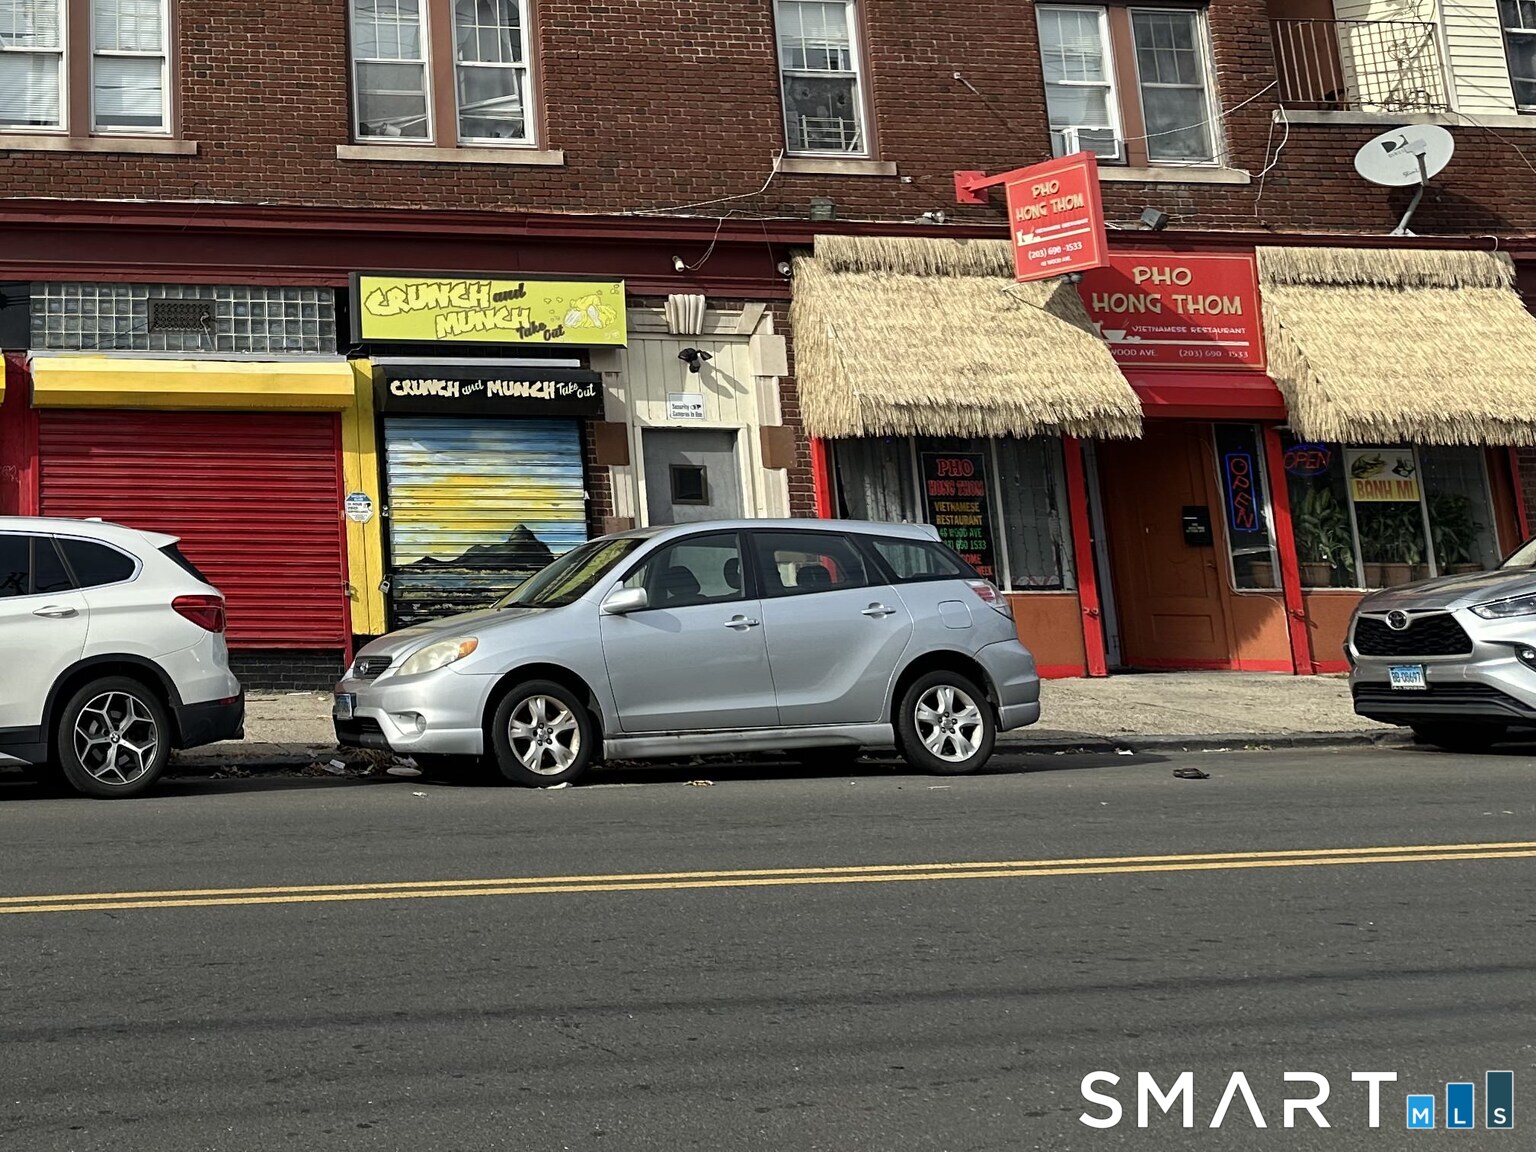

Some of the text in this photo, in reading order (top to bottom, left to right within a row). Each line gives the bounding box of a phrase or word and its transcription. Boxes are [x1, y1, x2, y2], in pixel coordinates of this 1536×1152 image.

[1031, 180, 1059, 198] PHO
[1016, 193, 1084, 221] HONG THOM
[1028, 248, 1047, 260] (203)
[1132, 266, 1192, 286] PHO
[364, 281, 526, 316] CRUNCH and
[1092, 293, 1243, 315] HONG THOM
[435, 306, 531, 339] MUNCH
[515, 321, 547, 340] Take
[1131, 325, 1187, 333] VIETNAMESE
[1179, 349, 1202, 357] (203)
[390, 379, 579, 398] CRUNCH and MUNCH Take
[936, 459, 974, 476] PHO
[1284, 451, 1331, 470] OPEN
[928, 480, 984, 496] HONG THOM
[1230, 458, 1254, 528] OPEN
[1356, 480, 1413, 498] BANH MI
[934, 501, 980, 512] VIETNAMESE
[936, 515, 982, 525] RESTAURANT
[949, 528, 967, 537] WOOD
[969, 528, 982, 537] AVE
[970, 540, 986, 549] 1533
